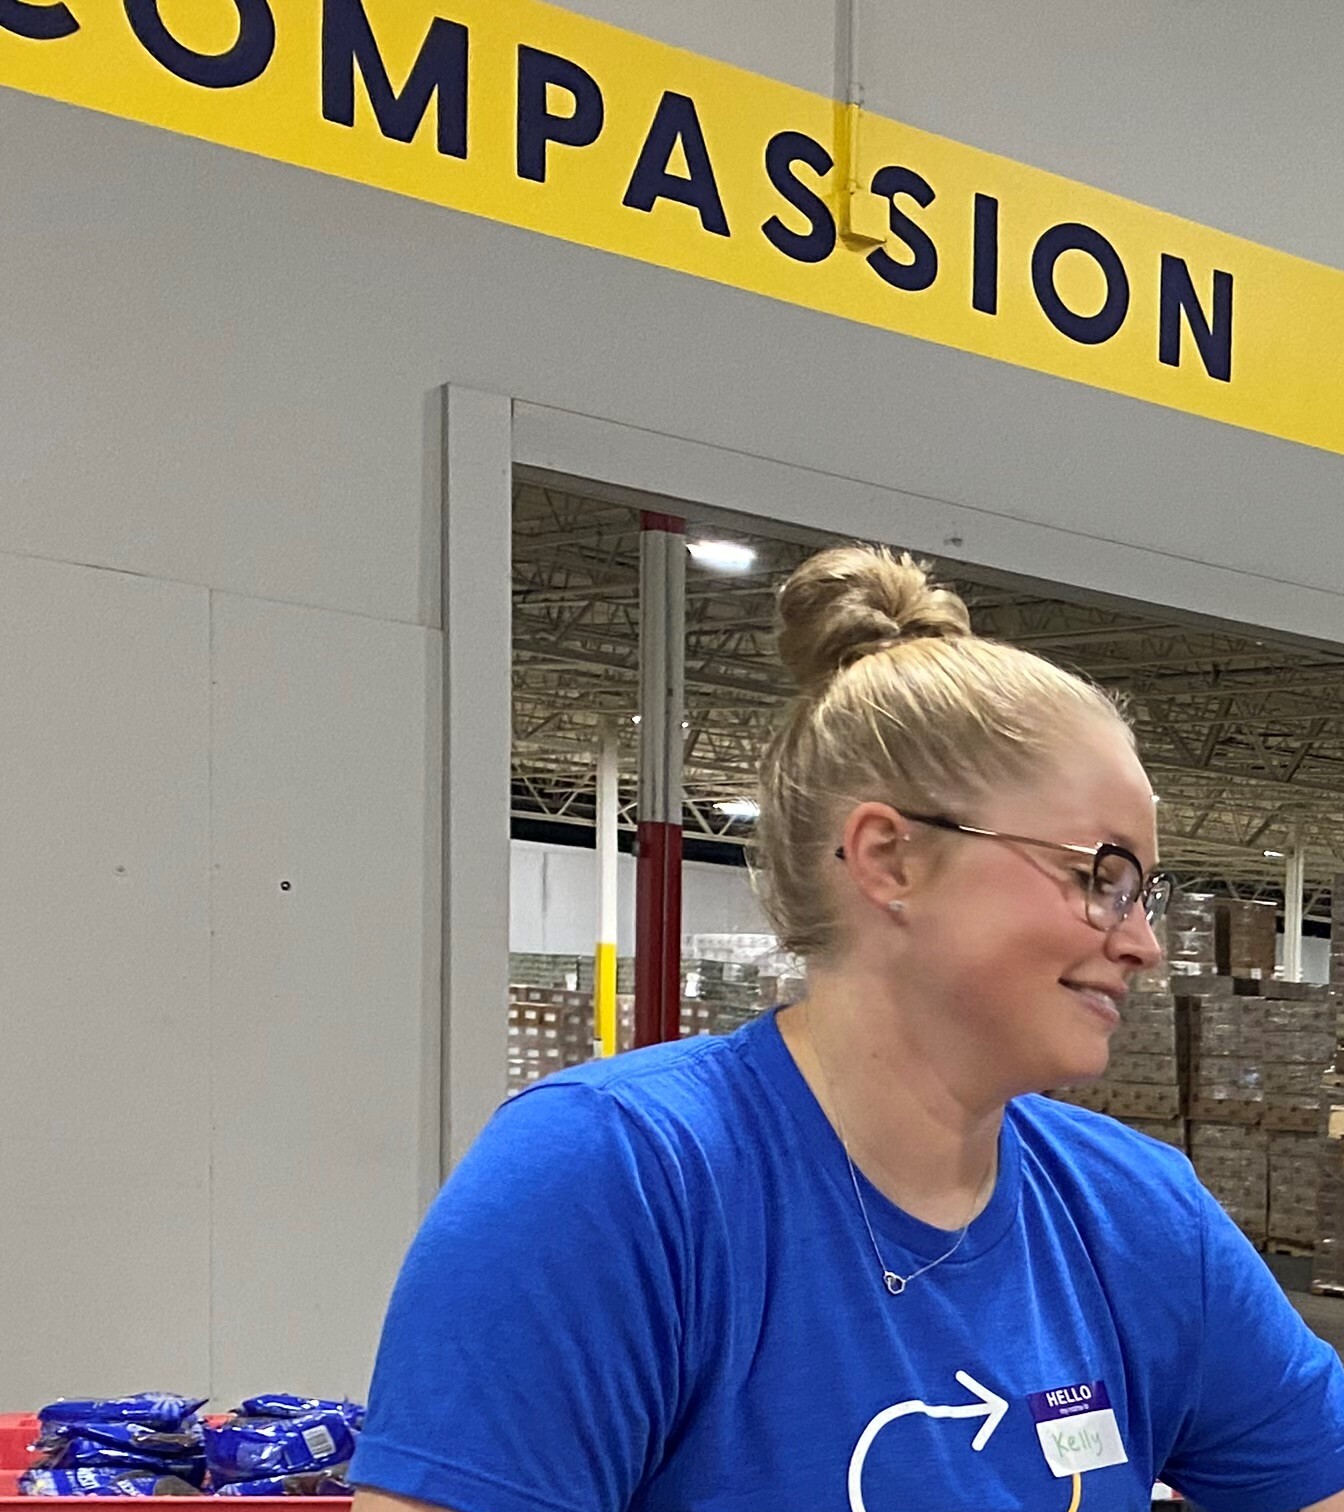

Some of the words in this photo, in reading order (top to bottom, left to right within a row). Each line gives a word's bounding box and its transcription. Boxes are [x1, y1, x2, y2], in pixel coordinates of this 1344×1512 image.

[0, 0, 1233, 382] OMPASSION
[1046, 1385, 1092, 1407] HELLO
[1052, 1428, 1103, 1458] Kelly
